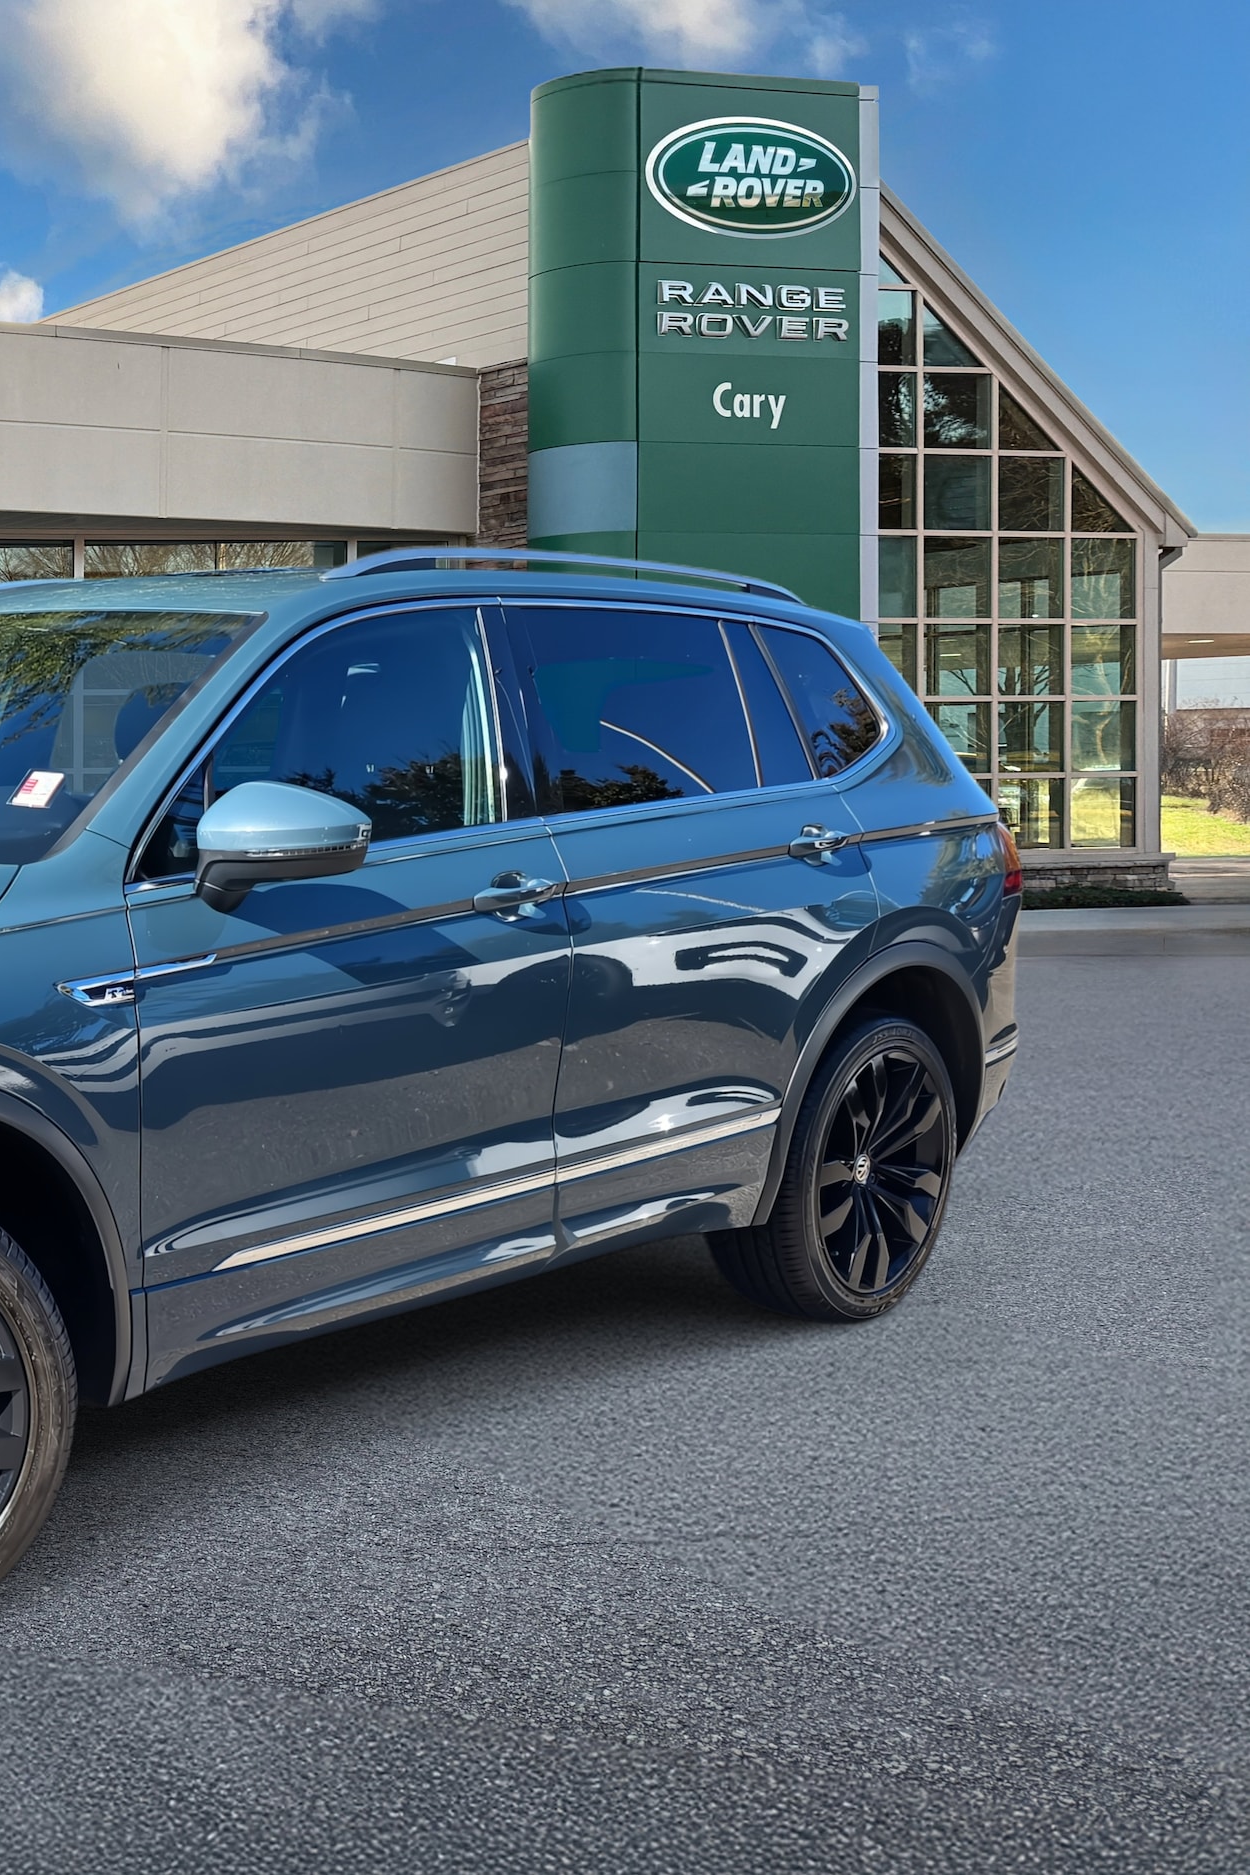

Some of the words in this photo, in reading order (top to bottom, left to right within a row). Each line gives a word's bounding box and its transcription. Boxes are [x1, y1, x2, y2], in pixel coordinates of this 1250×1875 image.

[698, 141, 796, 175] LAND
[710, 176, 825, 208] ROVER
[657, 279, 847, 312] RANGE
[657, 311, 849, 343] ROVER
[712, 382, 787, 429] Cary
